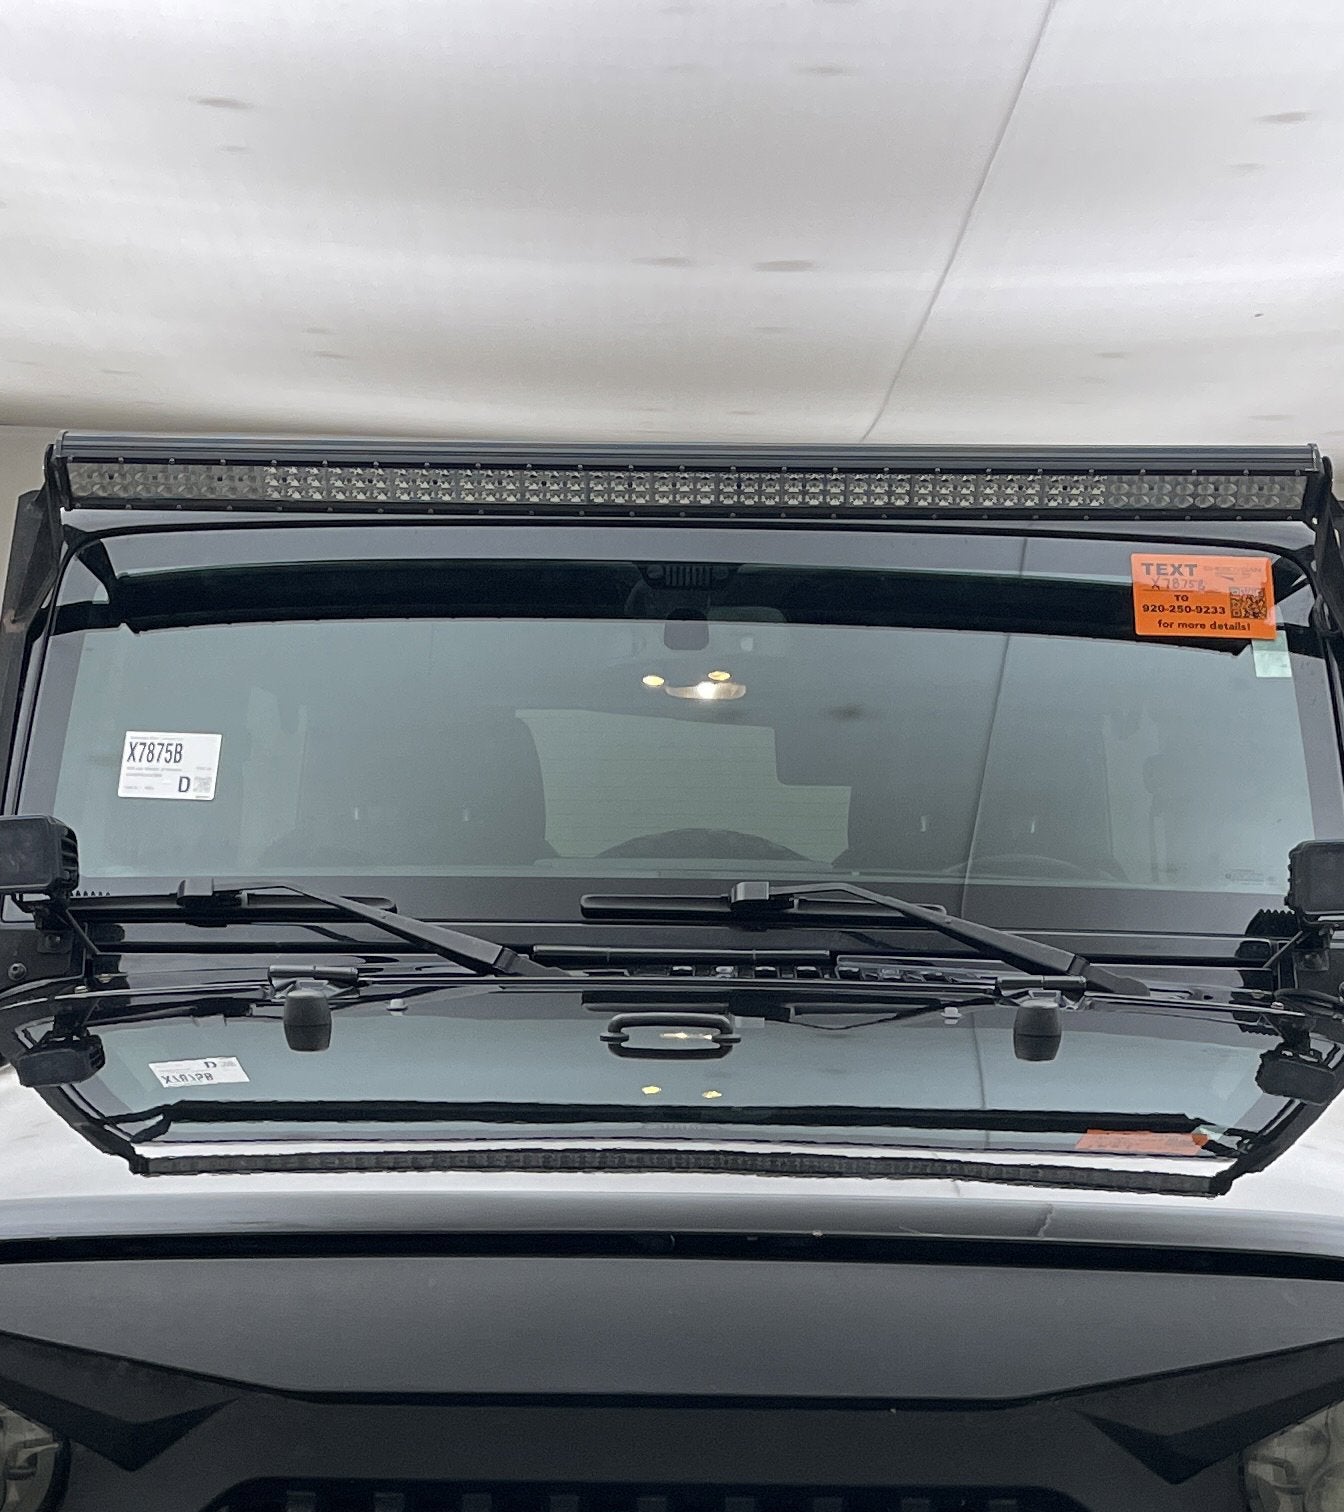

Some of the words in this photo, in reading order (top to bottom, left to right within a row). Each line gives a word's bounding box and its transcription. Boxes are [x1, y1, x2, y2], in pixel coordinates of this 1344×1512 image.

[1141, 562, 1198, 577] TEXT
[1173, 594, 1190, 602] TO
[1142, 603, 1226, 615] 920-250-9233
[1157, 619, 1175, 629] for
[1177, 621, 1206, 630] more
[1209, 620, 1251, 632] details!
[126, 741, 183, 764] X7875B
[177, 775, 191, 793] D
